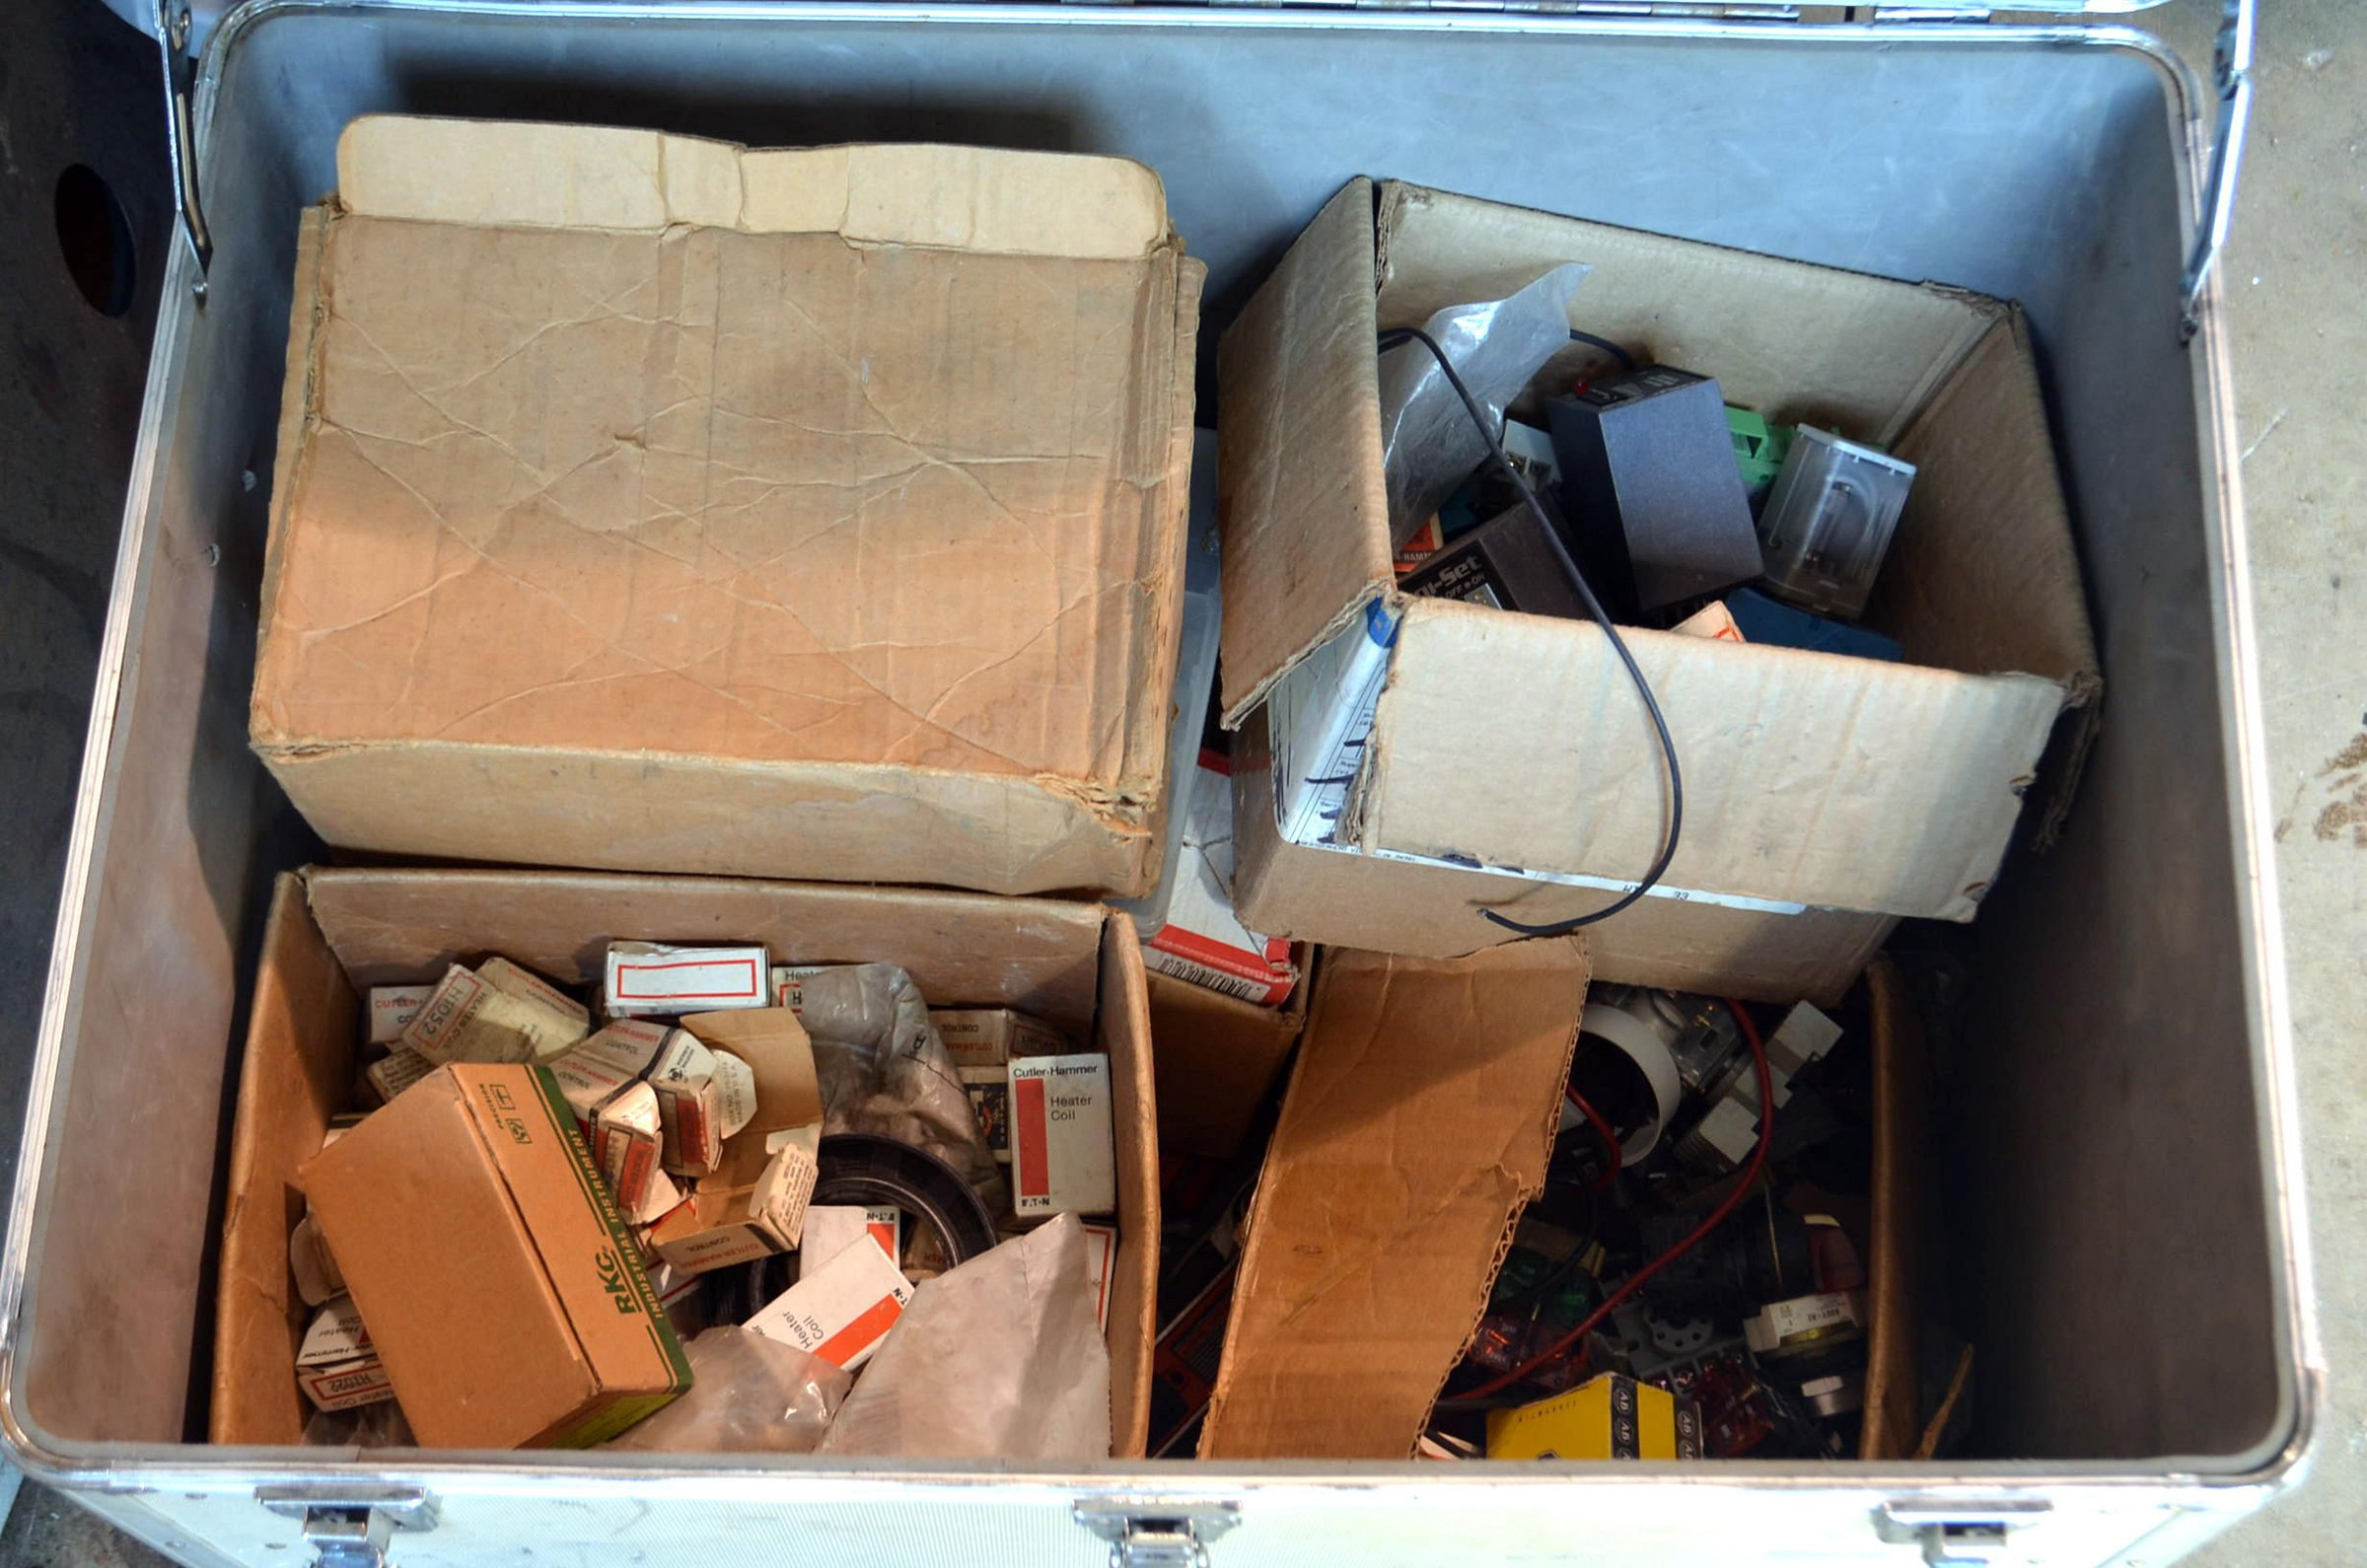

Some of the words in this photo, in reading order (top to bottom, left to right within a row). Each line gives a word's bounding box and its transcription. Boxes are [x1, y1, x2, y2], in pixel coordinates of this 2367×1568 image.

[1050, 1096, 1092, 1107] Heater
[1050, 1109, 1076, 1121] Coil
[568, 1129, 619, 1223] INSTRUMENT
[596, 1251, 637, 1315] RKC
[618, 1232, 664, 1319] INDUSTRIAL
[783, 1311, 814, 1349] Heater
[803, 1316, 825, 1340] Coil
